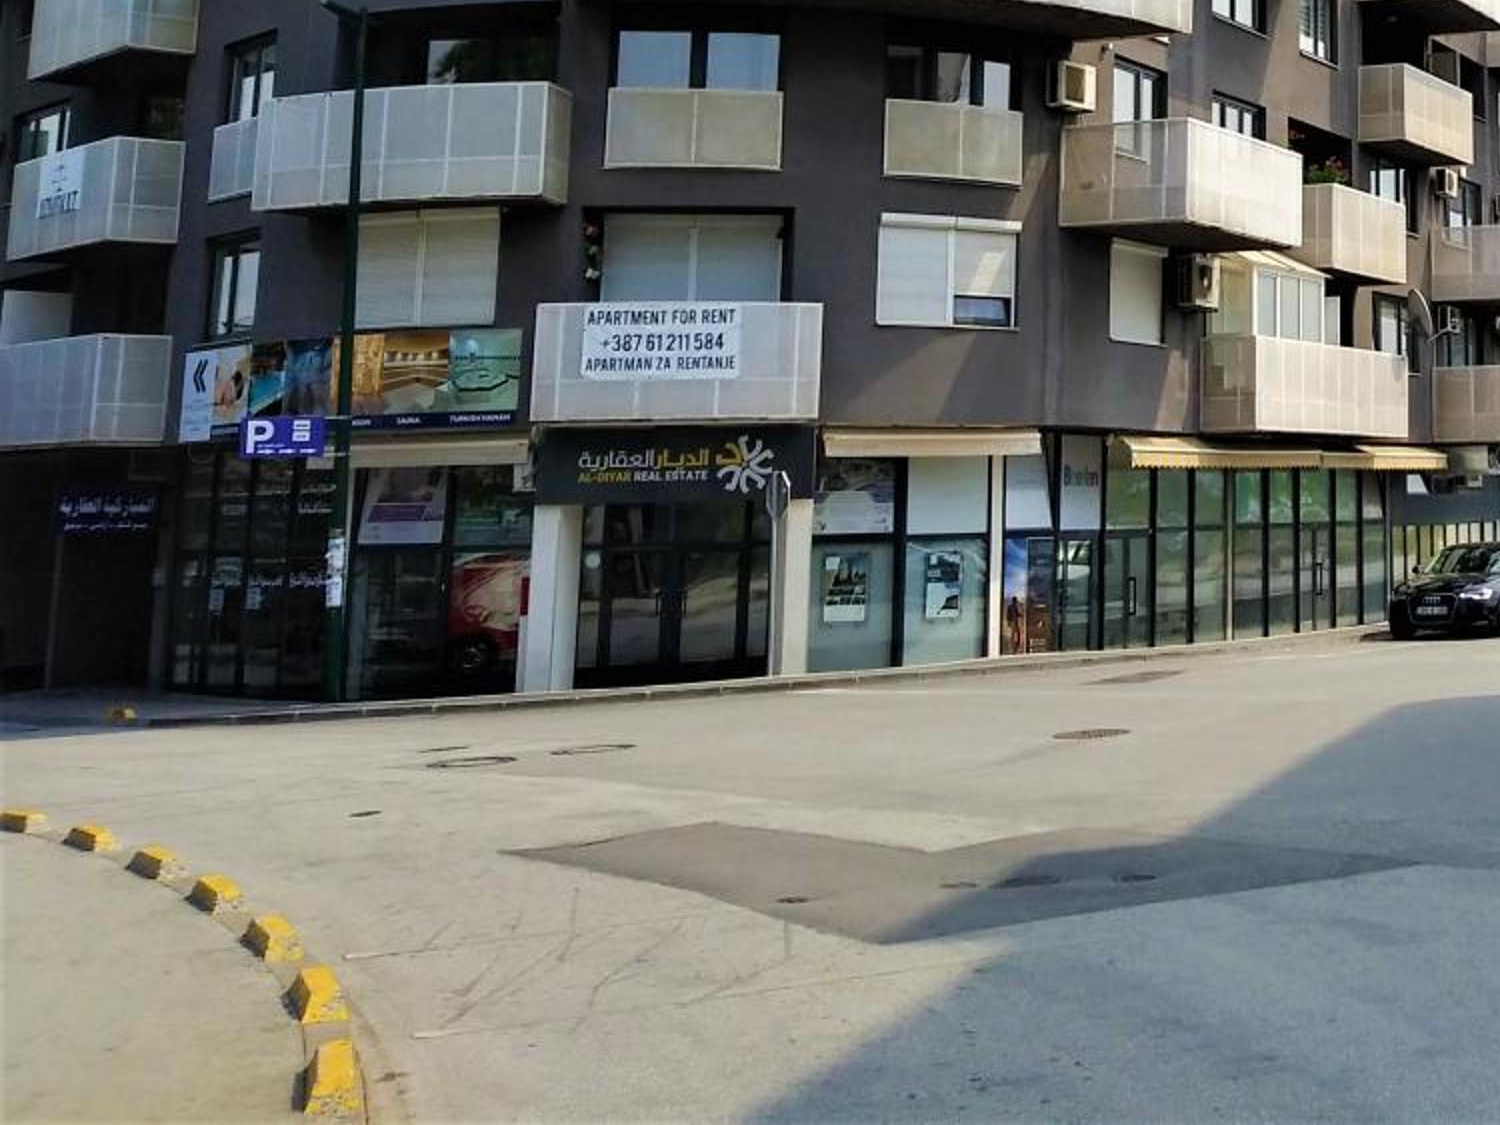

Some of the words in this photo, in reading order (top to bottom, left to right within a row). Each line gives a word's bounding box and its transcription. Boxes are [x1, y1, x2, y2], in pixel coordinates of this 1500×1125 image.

[587, 310, 666, 325] APARTMENT
[671, 309, 697, 324] FOR
[701, 308, 736, 324] RENT
[585, 357, 652, 372] APARTMAN
[656, 356, 671, 370] ZA
[676, 355, 735, 370] RENTANJE
[245, 420, 275, 454] P
[633, 472, 663, 482] REAL
[665, 470, 707, 481] ESTATE
